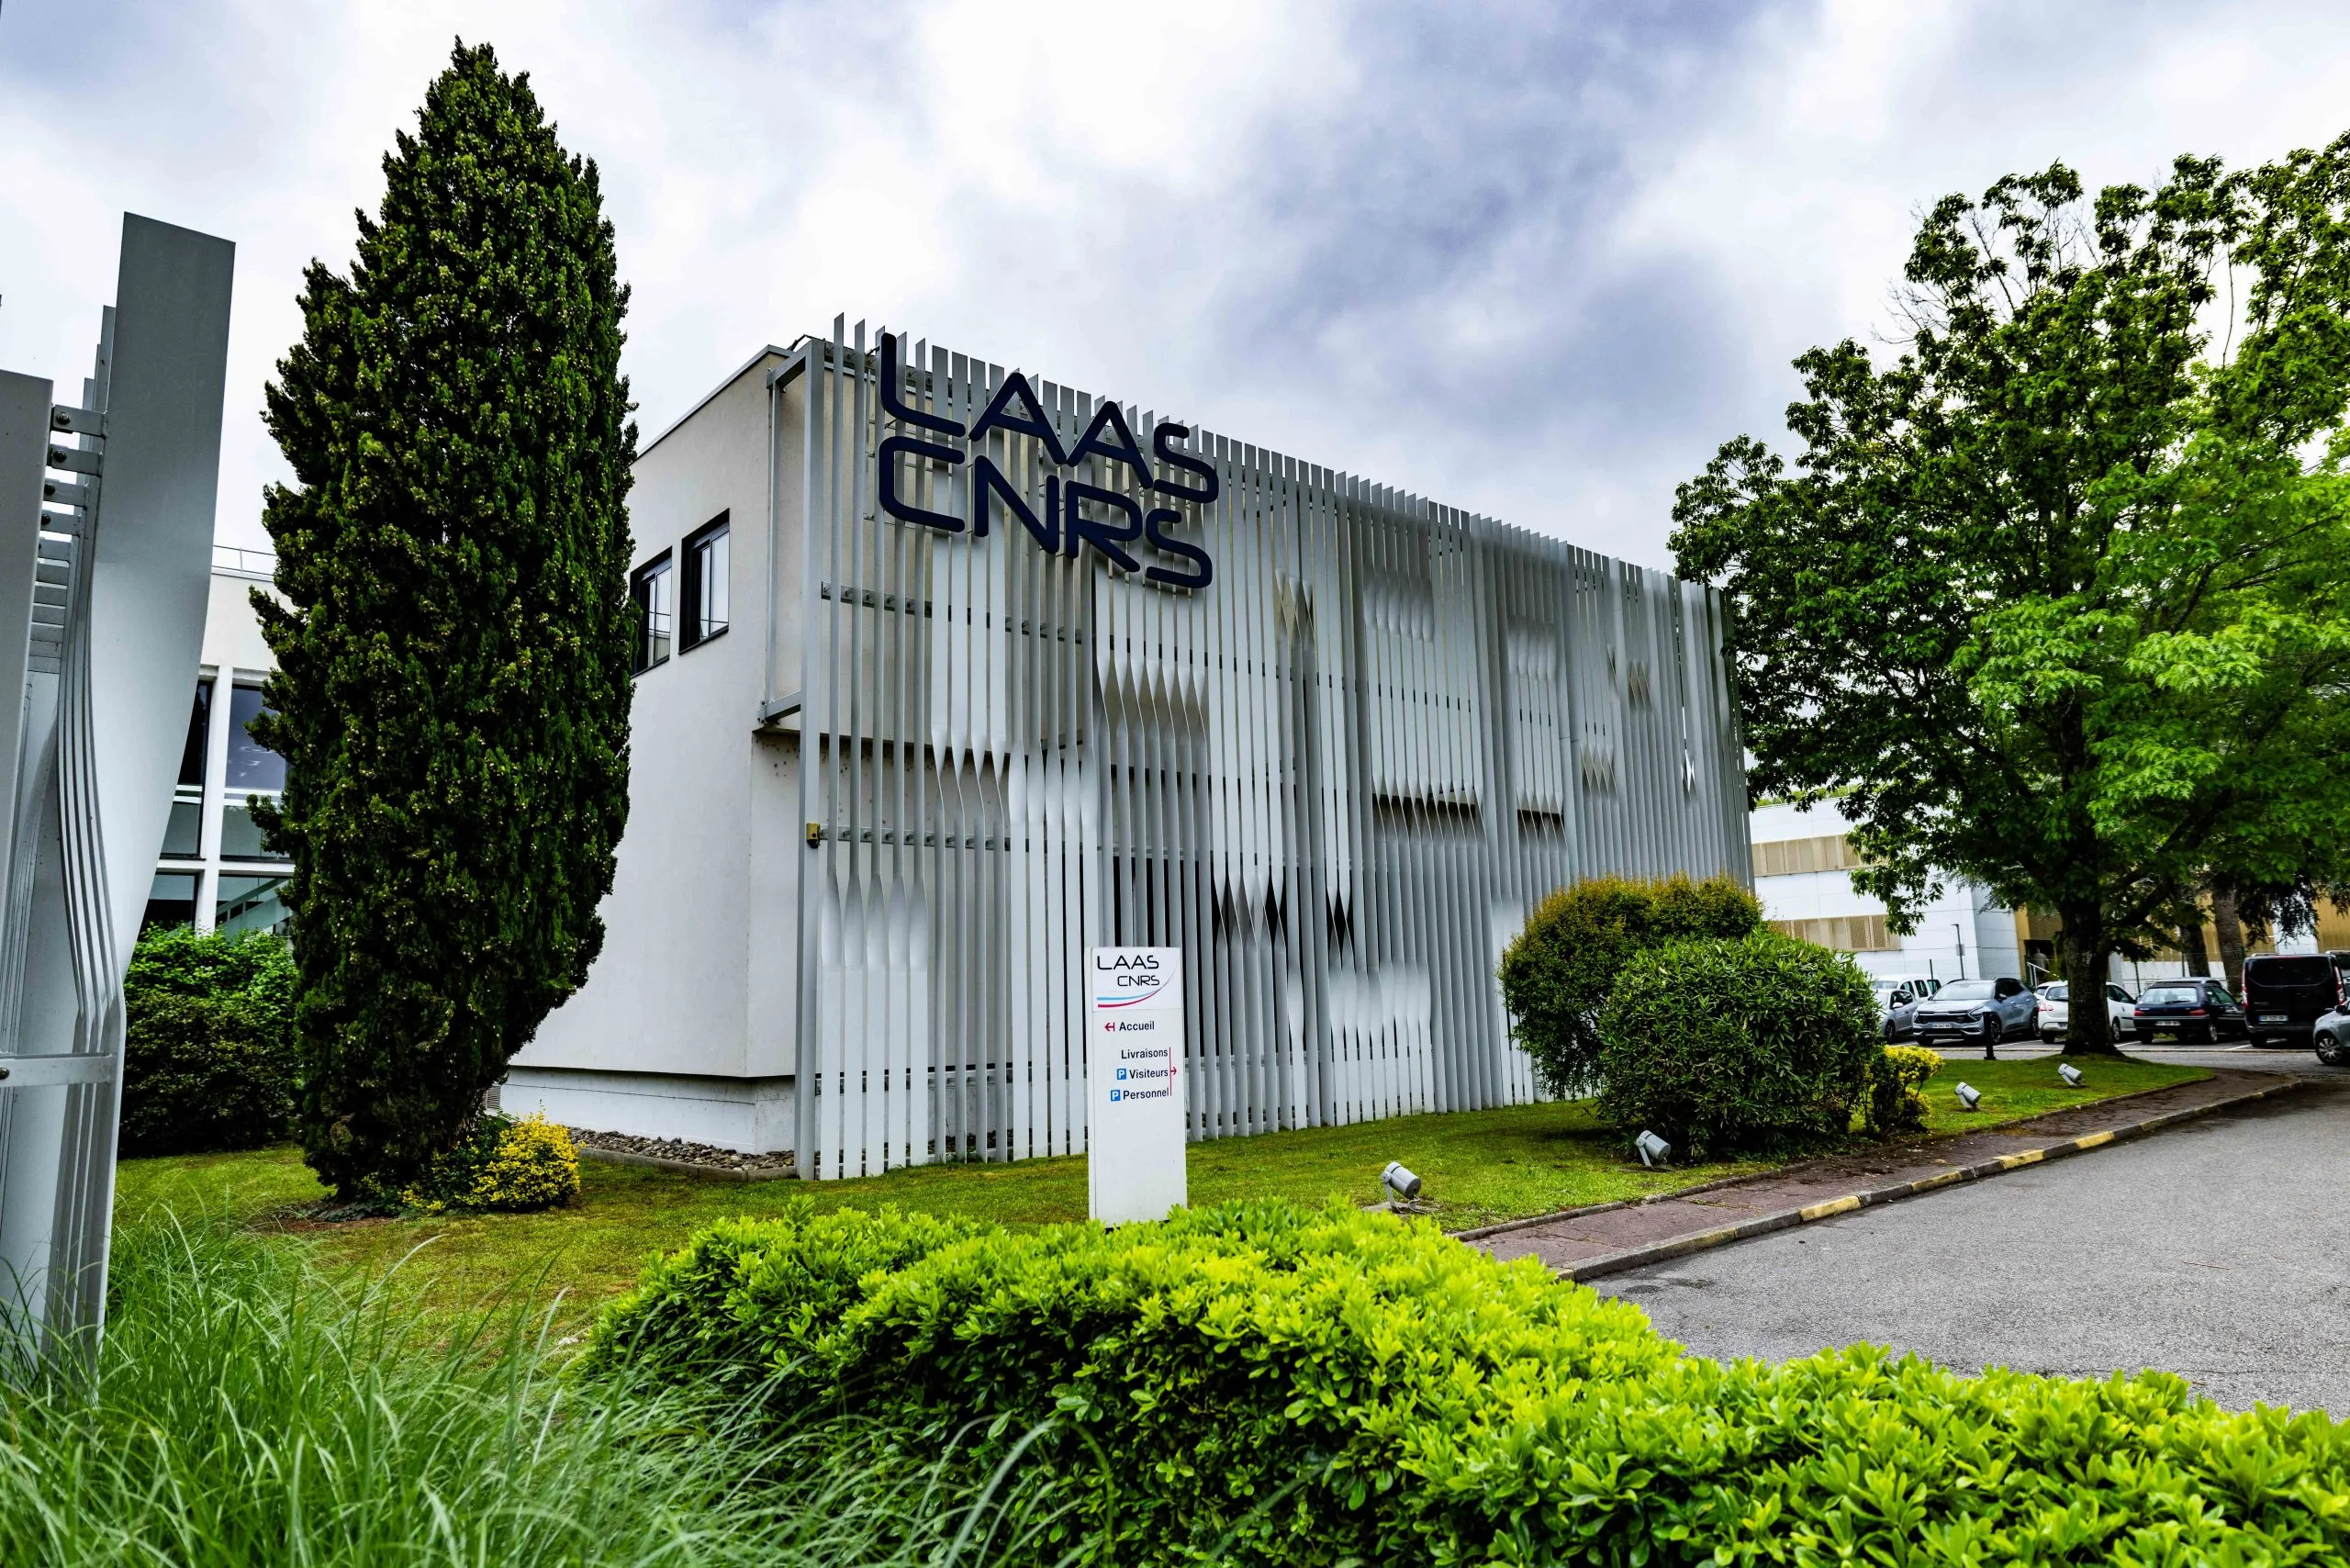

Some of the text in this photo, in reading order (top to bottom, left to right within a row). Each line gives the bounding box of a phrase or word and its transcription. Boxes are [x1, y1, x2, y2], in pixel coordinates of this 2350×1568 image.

[880, 332, 1219, 503] LAAS
[878, 436, 1213, 588] CNRS
[1097, 955, 1159, 969] LAAS
[1117, 975, 1159, 986] CNRS
[1119, 1021, 1155, 1031] Accueil
[1121, 1048, 1169, 1059] Livraisons
[1129, 1069, 1169, 1079] Visiteurs
[1123, 1087, 1169, 1100] Personnel
